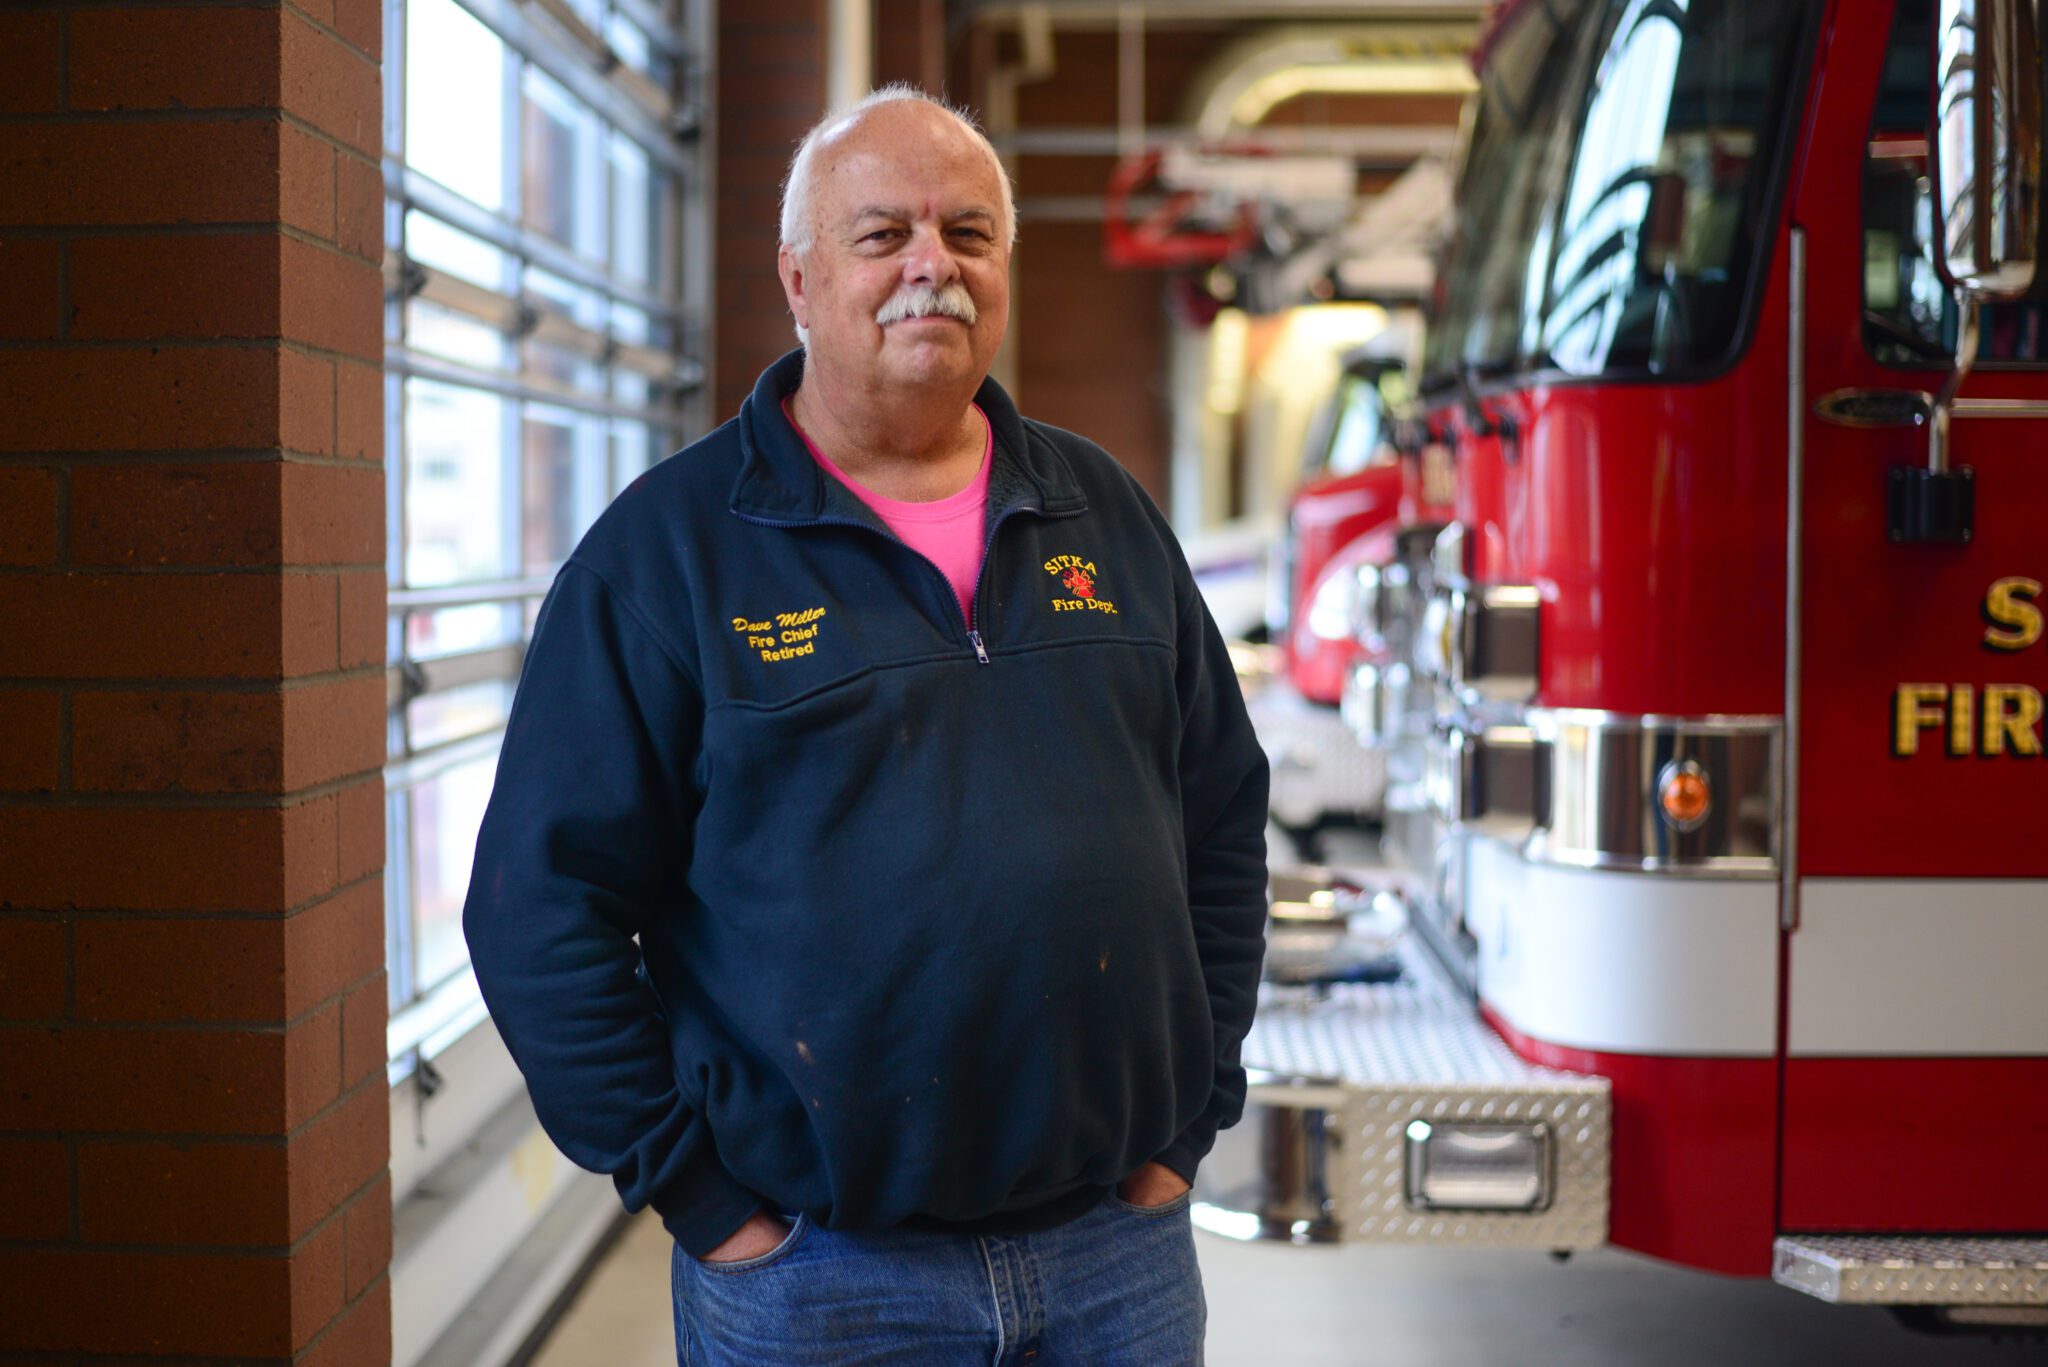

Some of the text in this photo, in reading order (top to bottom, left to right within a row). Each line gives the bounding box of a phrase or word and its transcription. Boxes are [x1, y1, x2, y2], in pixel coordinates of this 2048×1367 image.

[1044, 555, 1097, 575] SITKA
[1052, 598, 1118, 614] Fire Dept.
[1982, 576, 2045, 651] S
[732, 607, 825, 632] Dave Miller
[748, 623, 818, 648] Fire Chief
[761, 641, 814, 661] Retired
[1892, 683, 2047, 757] FIR
